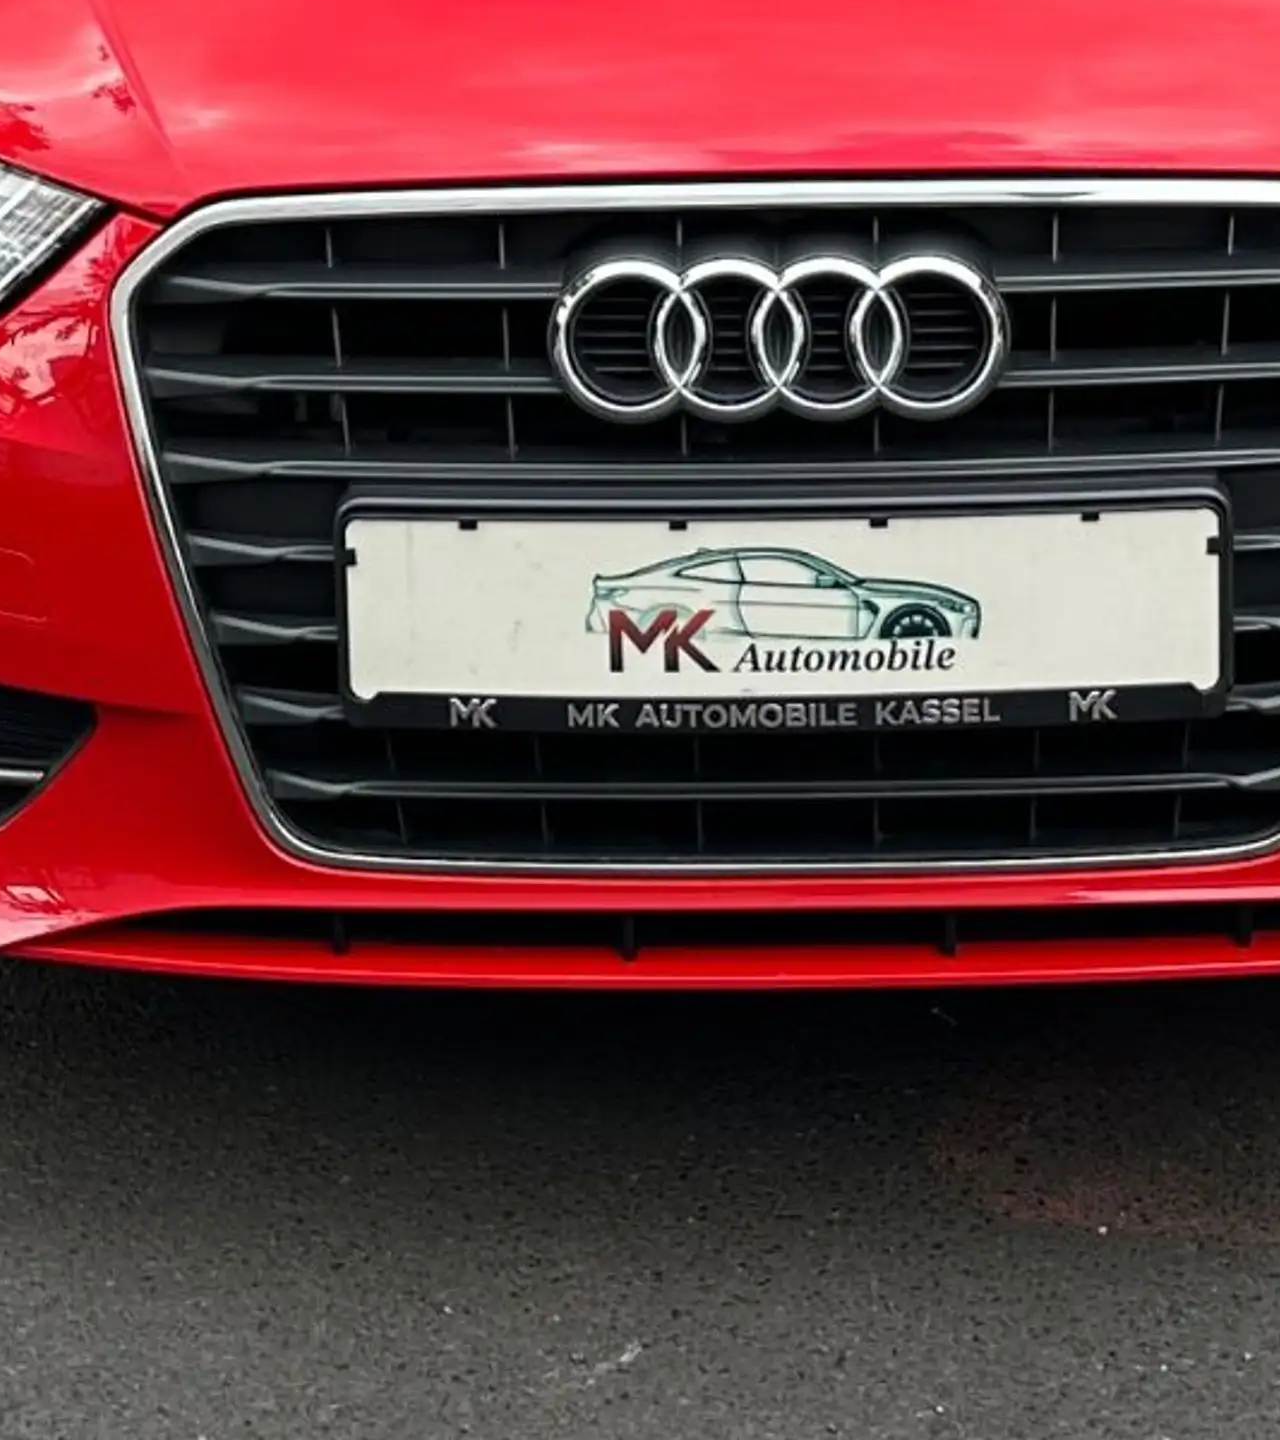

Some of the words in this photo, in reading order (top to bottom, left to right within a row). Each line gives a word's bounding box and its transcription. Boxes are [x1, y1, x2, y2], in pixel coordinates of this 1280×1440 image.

[608, 608, 721, 674] MK
[731, 639, 956, 674] Automobile
[448, 696, 498, 729] MK
[567, 702, 620, 728] MK
[634, 701, 858, 729] AUTOMOBILE
[874, 696, 1001, 727] KASSEL
[1069, 688, 1118, 722] MK
